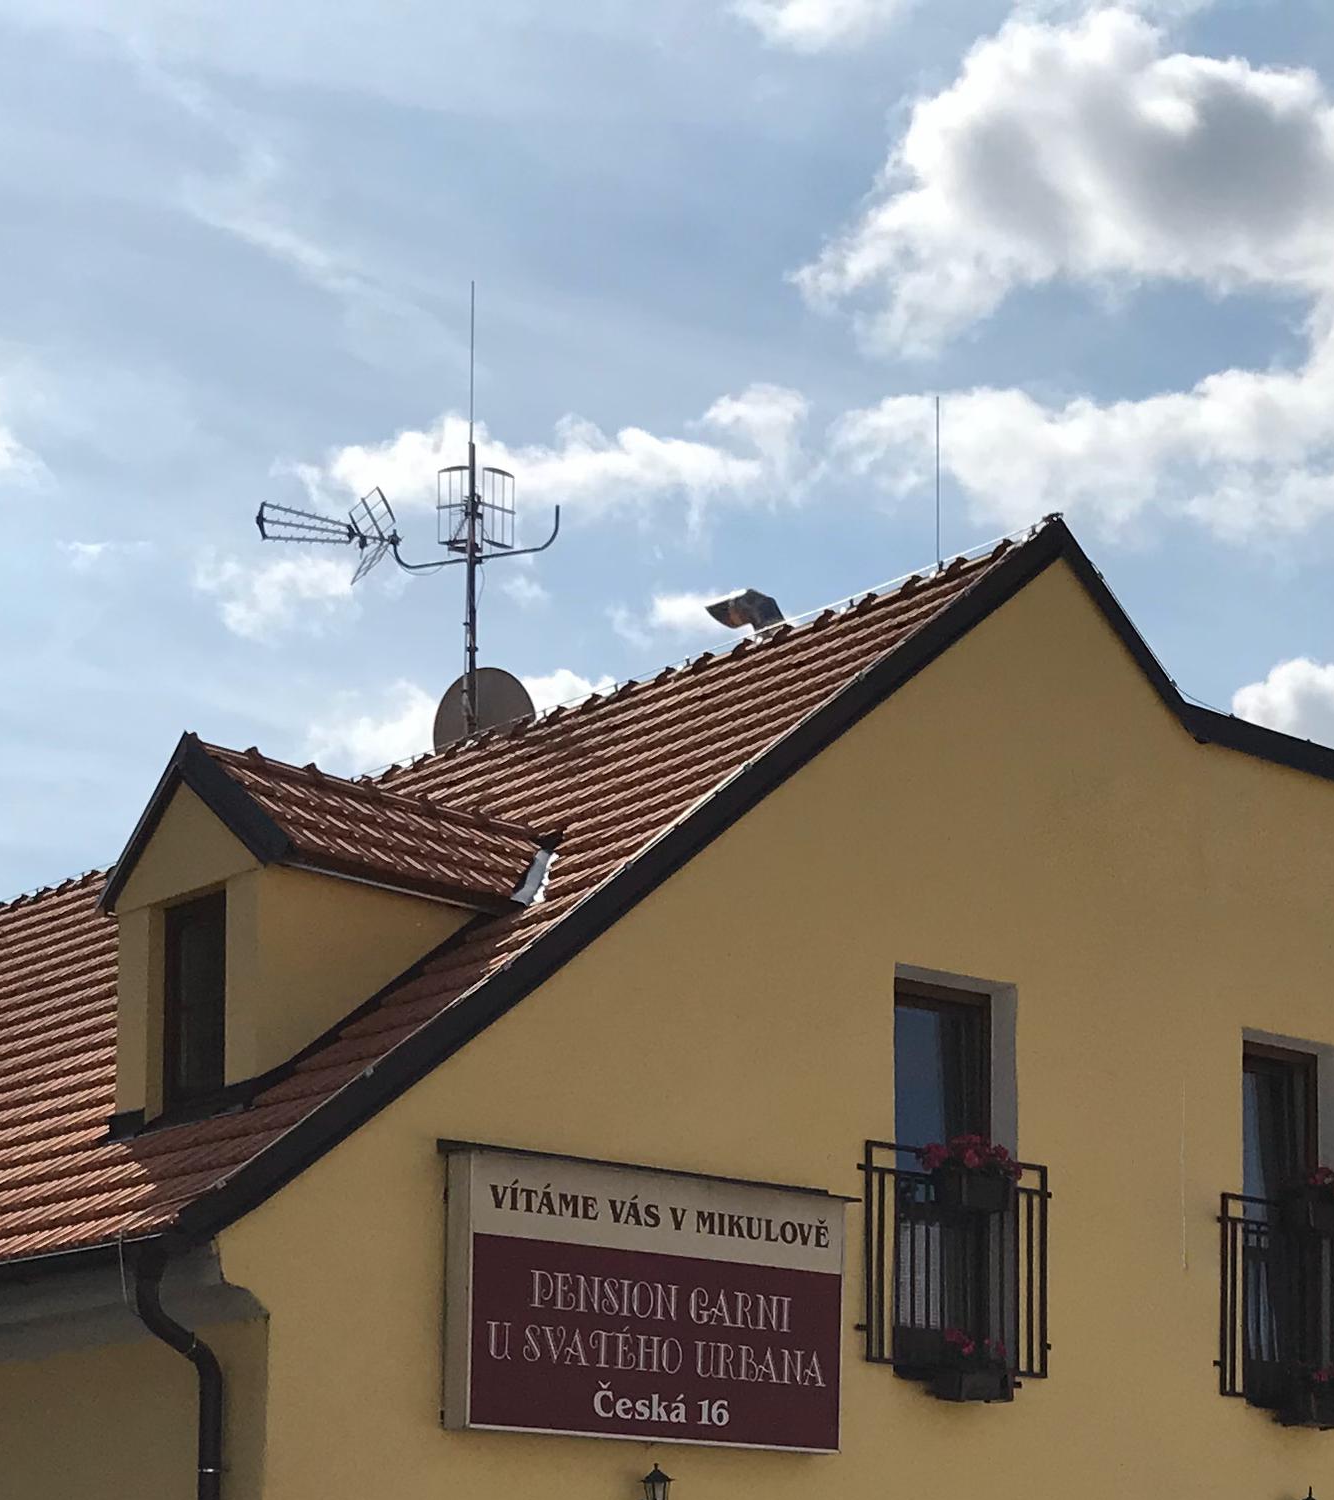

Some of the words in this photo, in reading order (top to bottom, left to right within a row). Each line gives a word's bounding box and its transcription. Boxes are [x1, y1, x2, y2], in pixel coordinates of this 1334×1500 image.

[489, 1179, 599, 1221] VÍTÁME
[608, 1195, 661, 1228] VÁS
[669, 1207, 687, 1232] V
[695, 1211, 830, 1249] MIKULOVĚ
[529, 1269, 679, 1322] PENSION
[688, 1287, 792, 1333] GARNI
[486, 1321, 512, 1360] U
[522, 1324, 683, 1375] SVATÉHO
[694, 1340, 826, 1387] URBANA
[593, 1381, 687, 1424] Česká
[697, 1399, 730, 1426] 16
